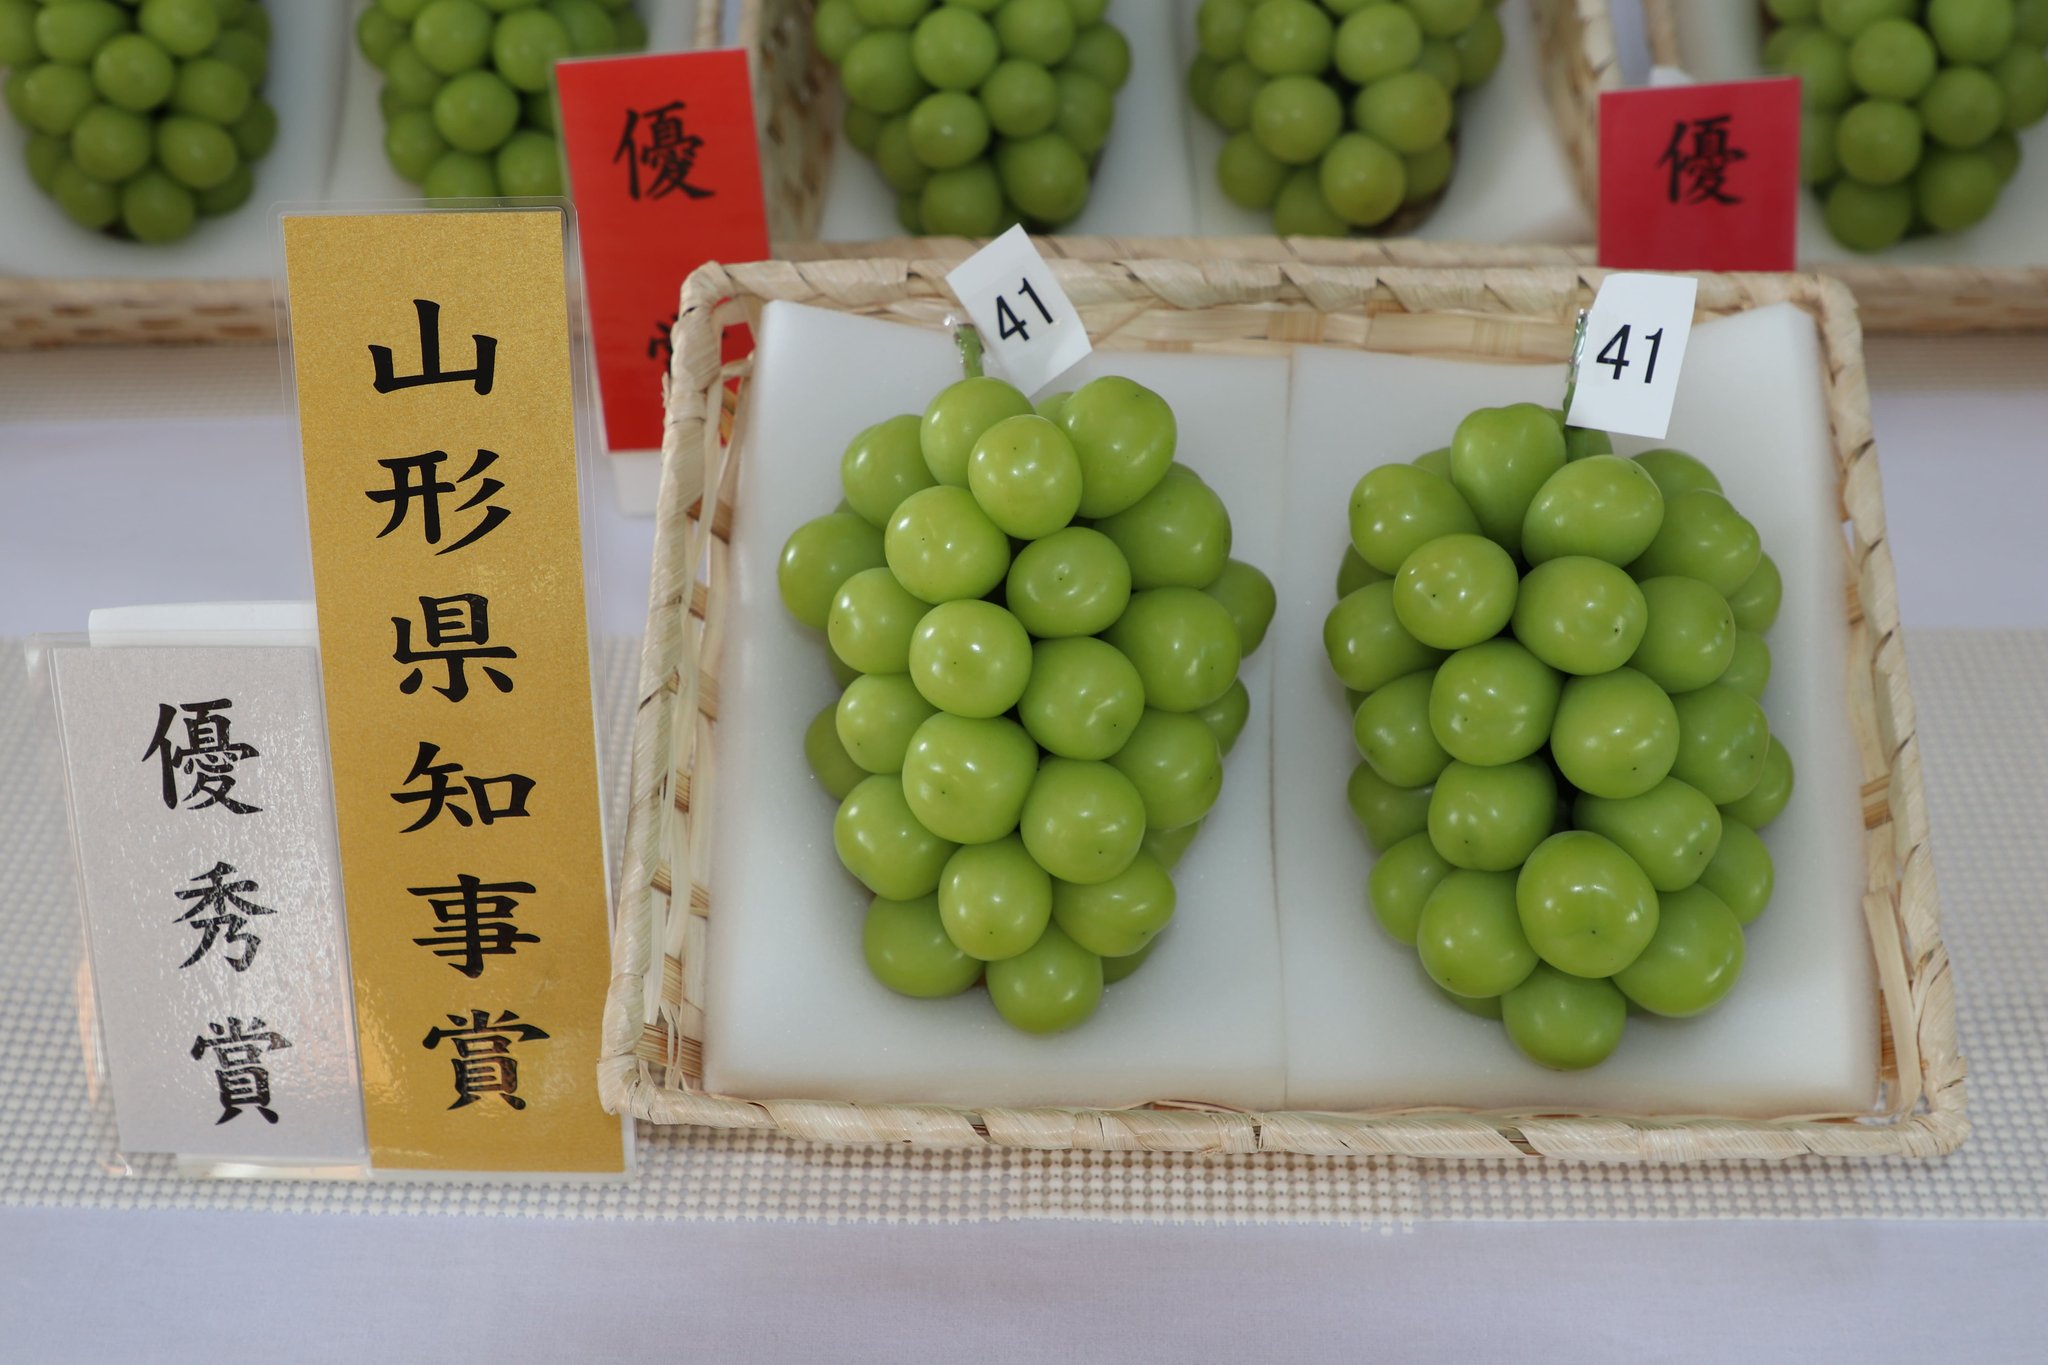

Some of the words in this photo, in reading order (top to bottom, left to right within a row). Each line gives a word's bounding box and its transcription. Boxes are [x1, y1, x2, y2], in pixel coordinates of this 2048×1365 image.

[1656, 114, 1747, 205] 優
[996, 277, 1054, 342] 41
[1595, 324, 1664, 384] 41
[365, 299, 550, 1111] 山形県知事賞
[141, 697, 293, 1126] 優秀賞
